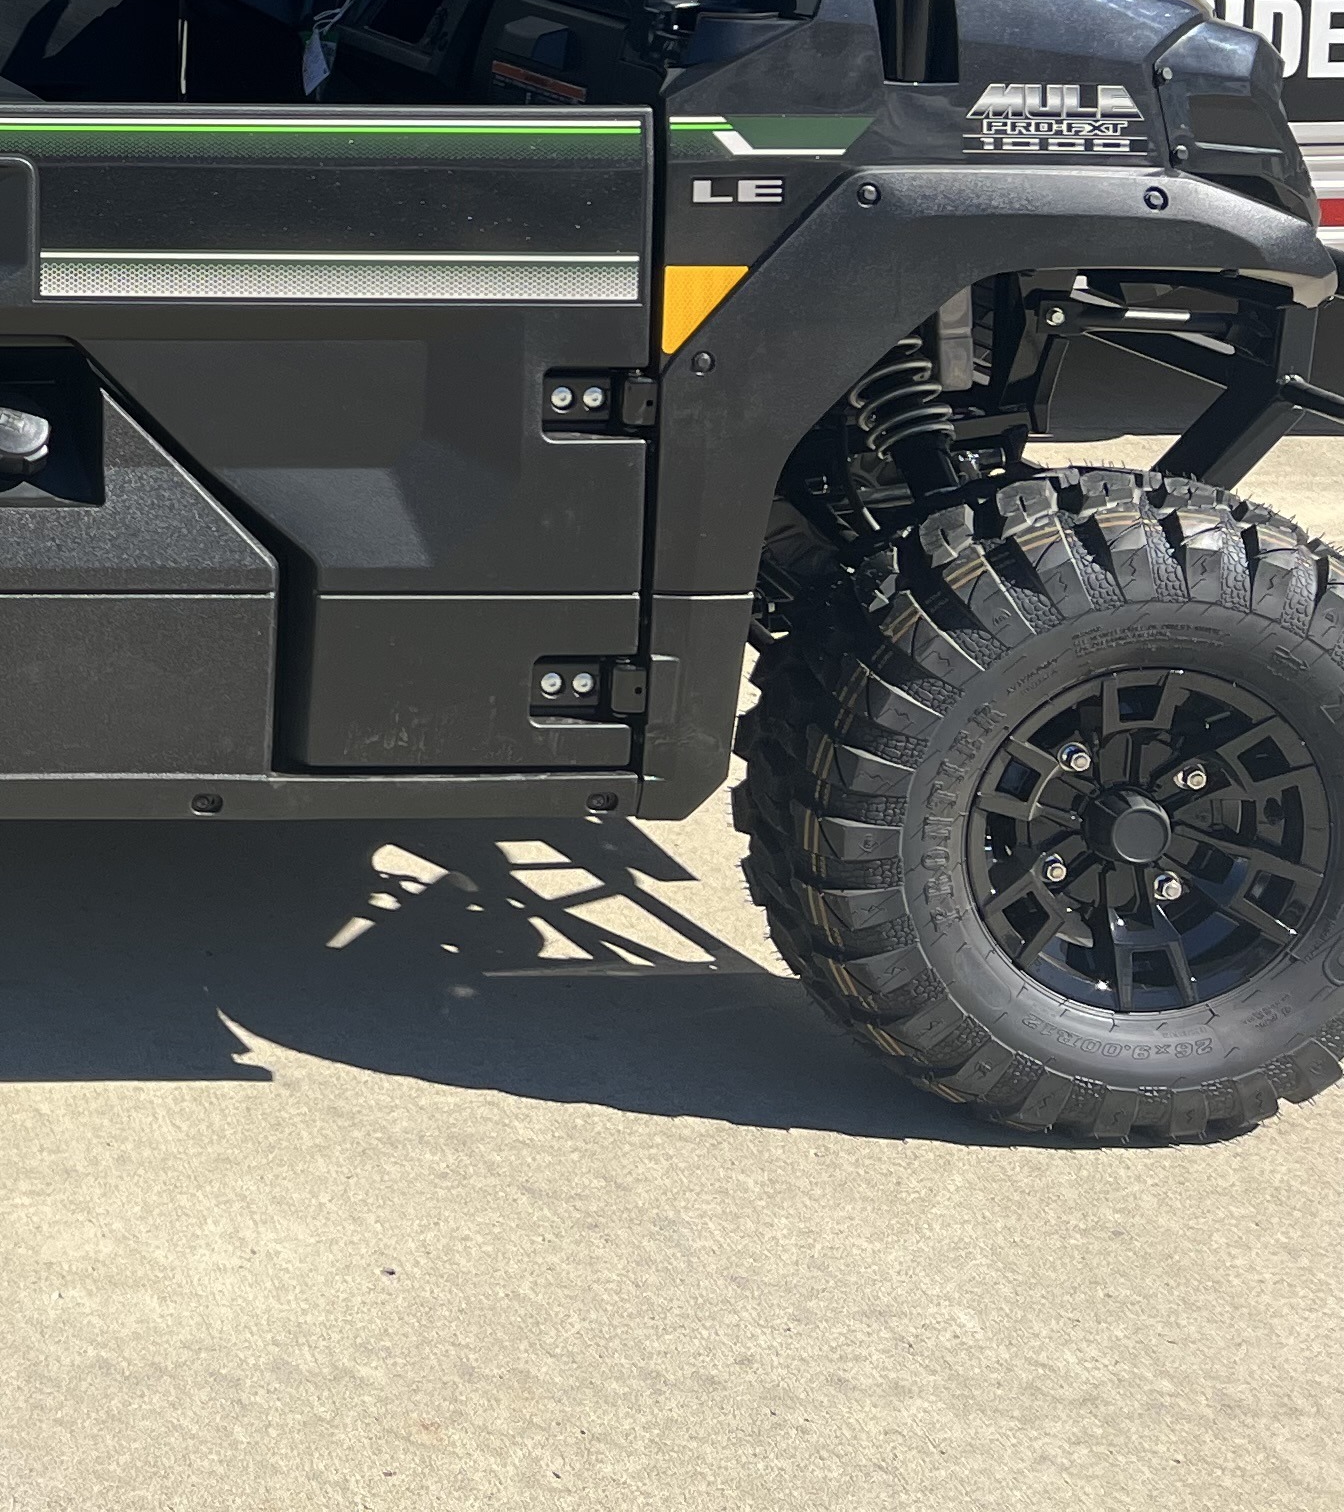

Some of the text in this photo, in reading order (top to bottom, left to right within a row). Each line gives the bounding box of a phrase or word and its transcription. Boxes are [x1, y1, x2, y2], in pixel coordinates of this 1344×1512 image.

[965, 83, 1145, 121] MULE
[979, 137, 1131, 152] 1000
[693, 179, 783, 203] LE
